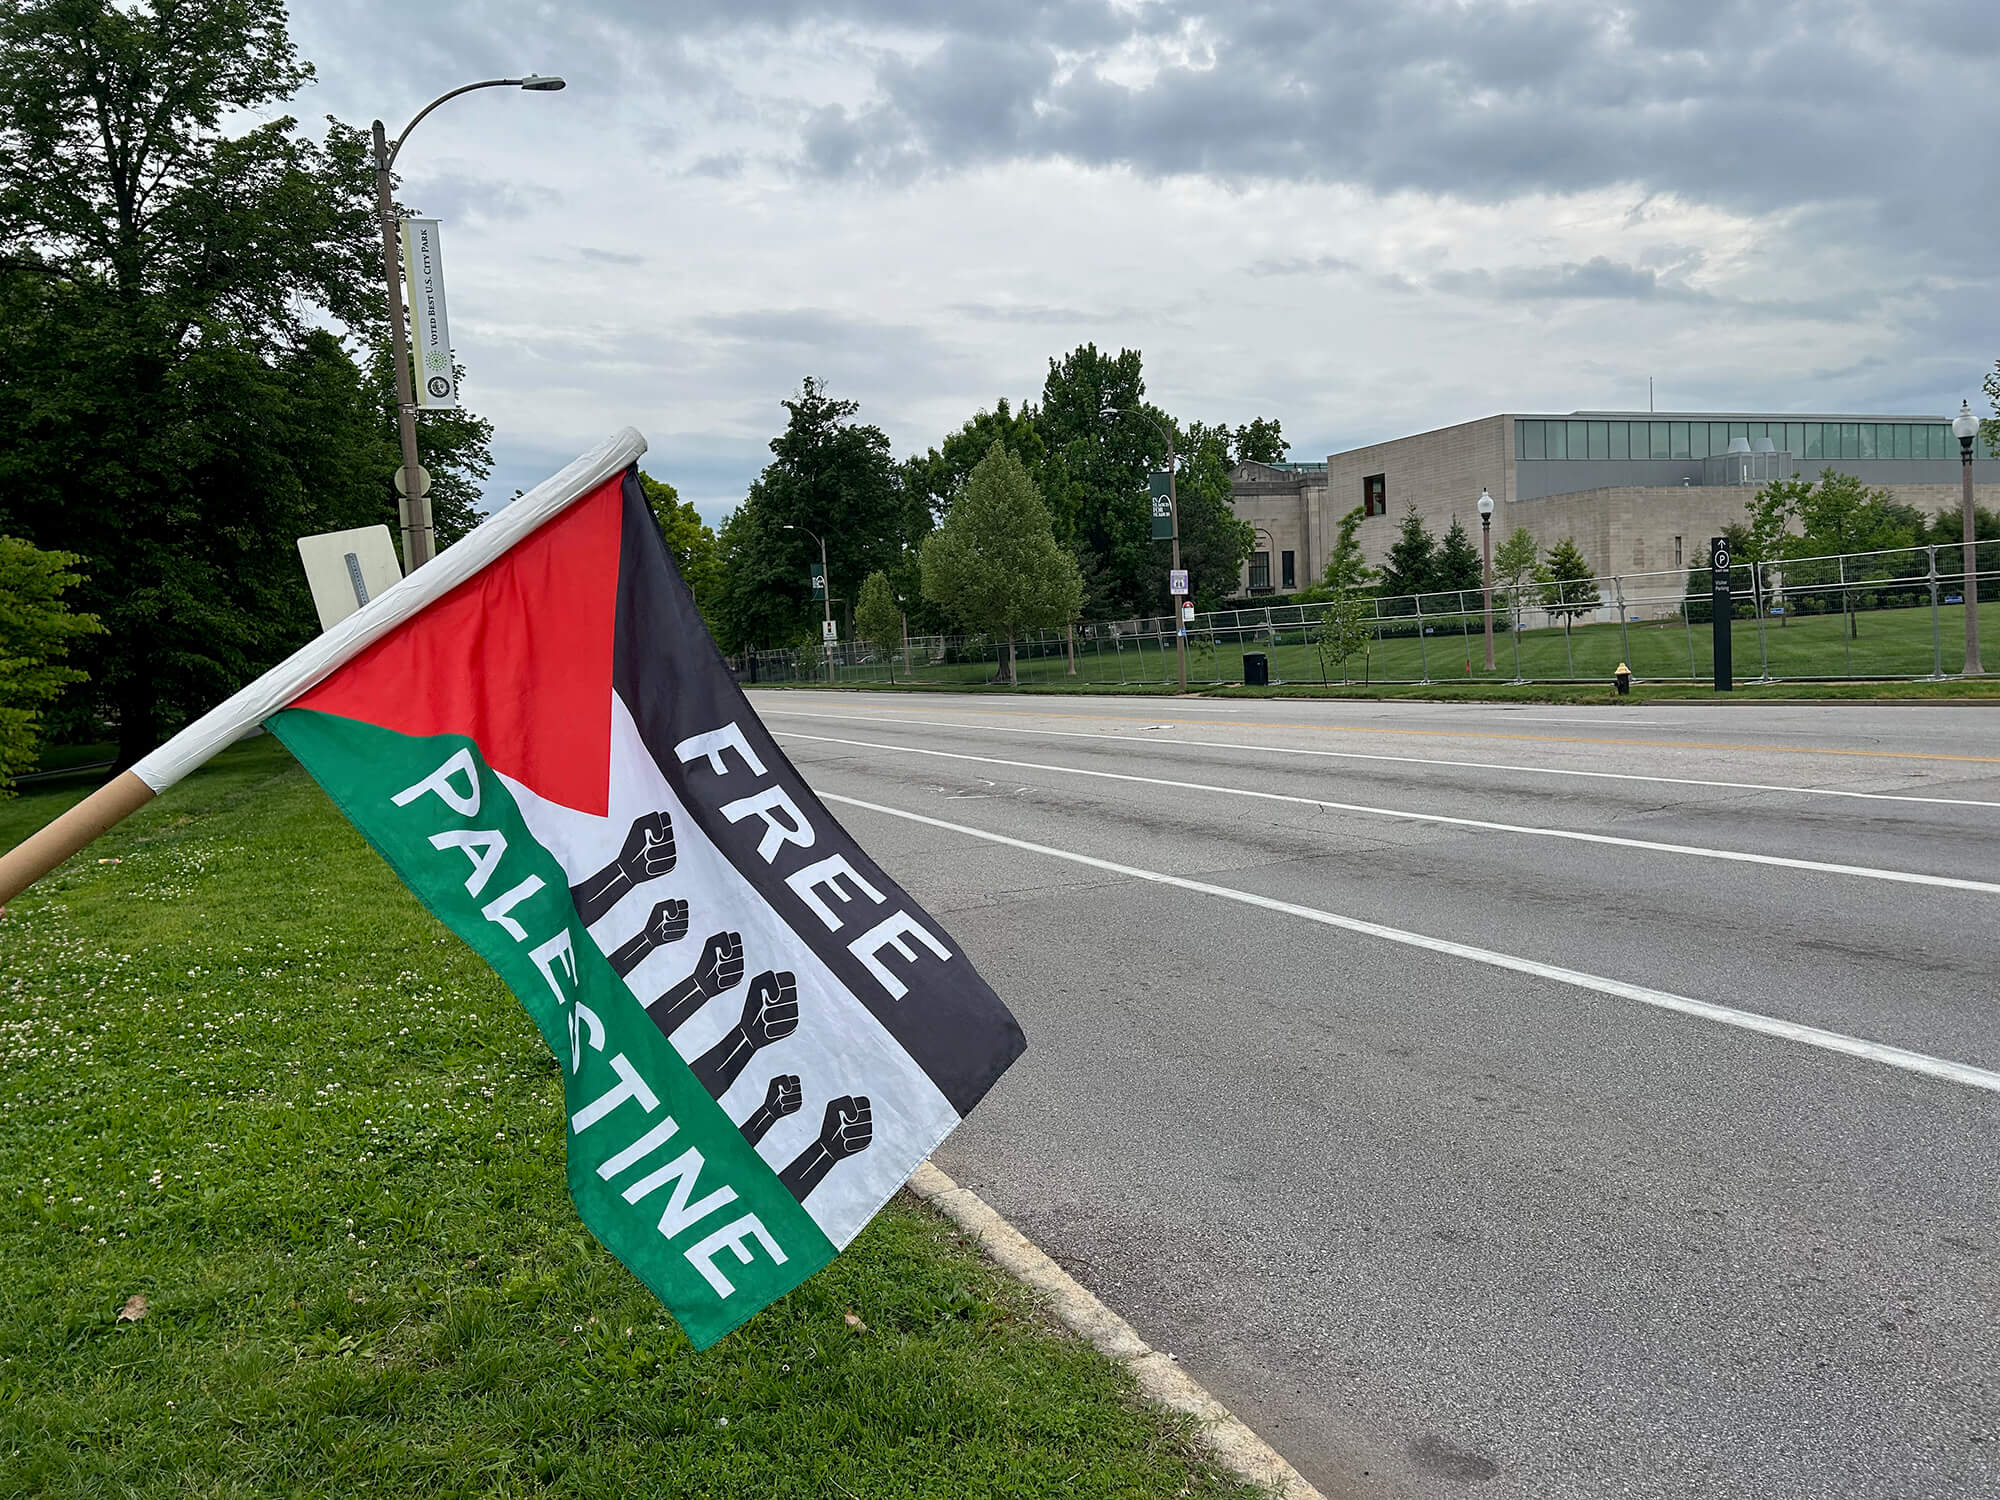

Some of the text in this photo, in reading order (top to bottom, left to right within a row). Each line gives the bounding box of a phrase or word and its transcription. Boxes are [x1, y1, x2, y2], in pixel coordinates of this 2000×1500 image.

[421, 229, 439, 346] VOTED BEST U.S. CITY PARK
[673, 721, 952, 1001] FREE
[392, 747, 788, 1299] PALESTINE
